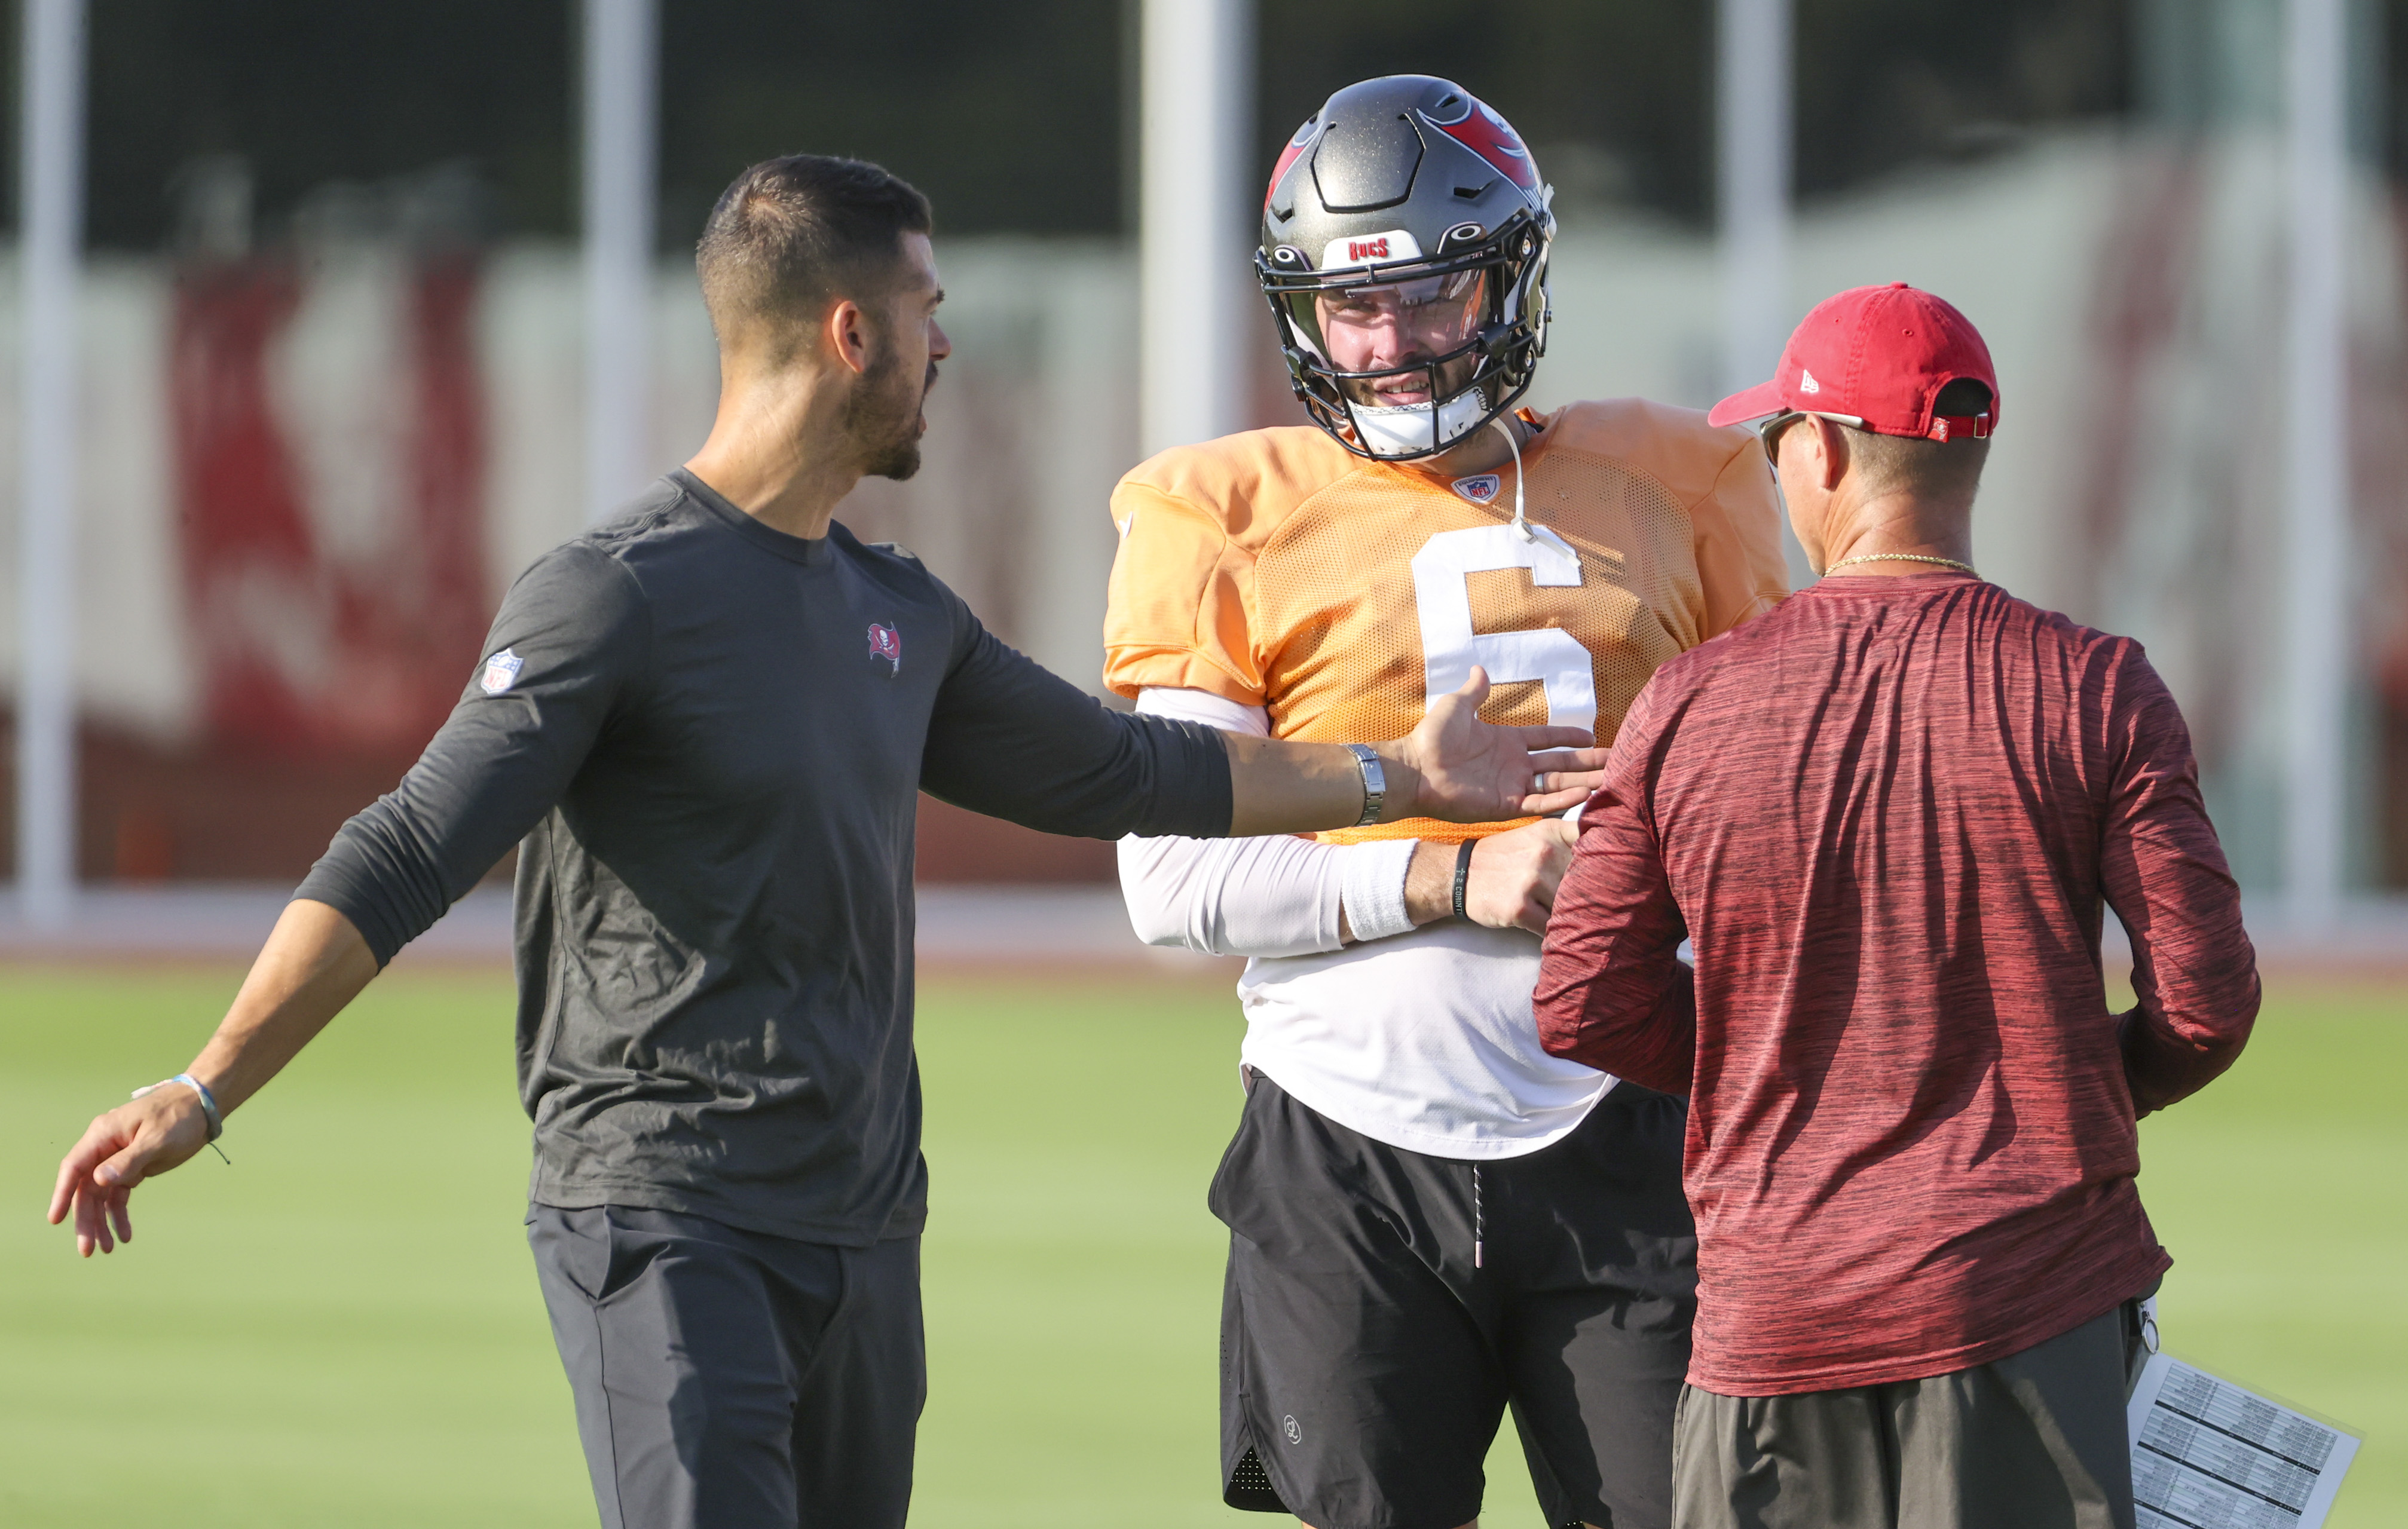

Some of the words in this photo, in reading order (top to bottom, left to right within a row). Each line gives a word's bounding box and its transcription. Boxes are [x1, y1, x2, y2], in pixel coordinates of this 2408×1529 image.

[1348, 238, 1388, 261] BUCS
[1471, 487, 1489, 496] NFL
[1412, 524, 1597, 754] 6
[484, 667, 507, 690] NFL
